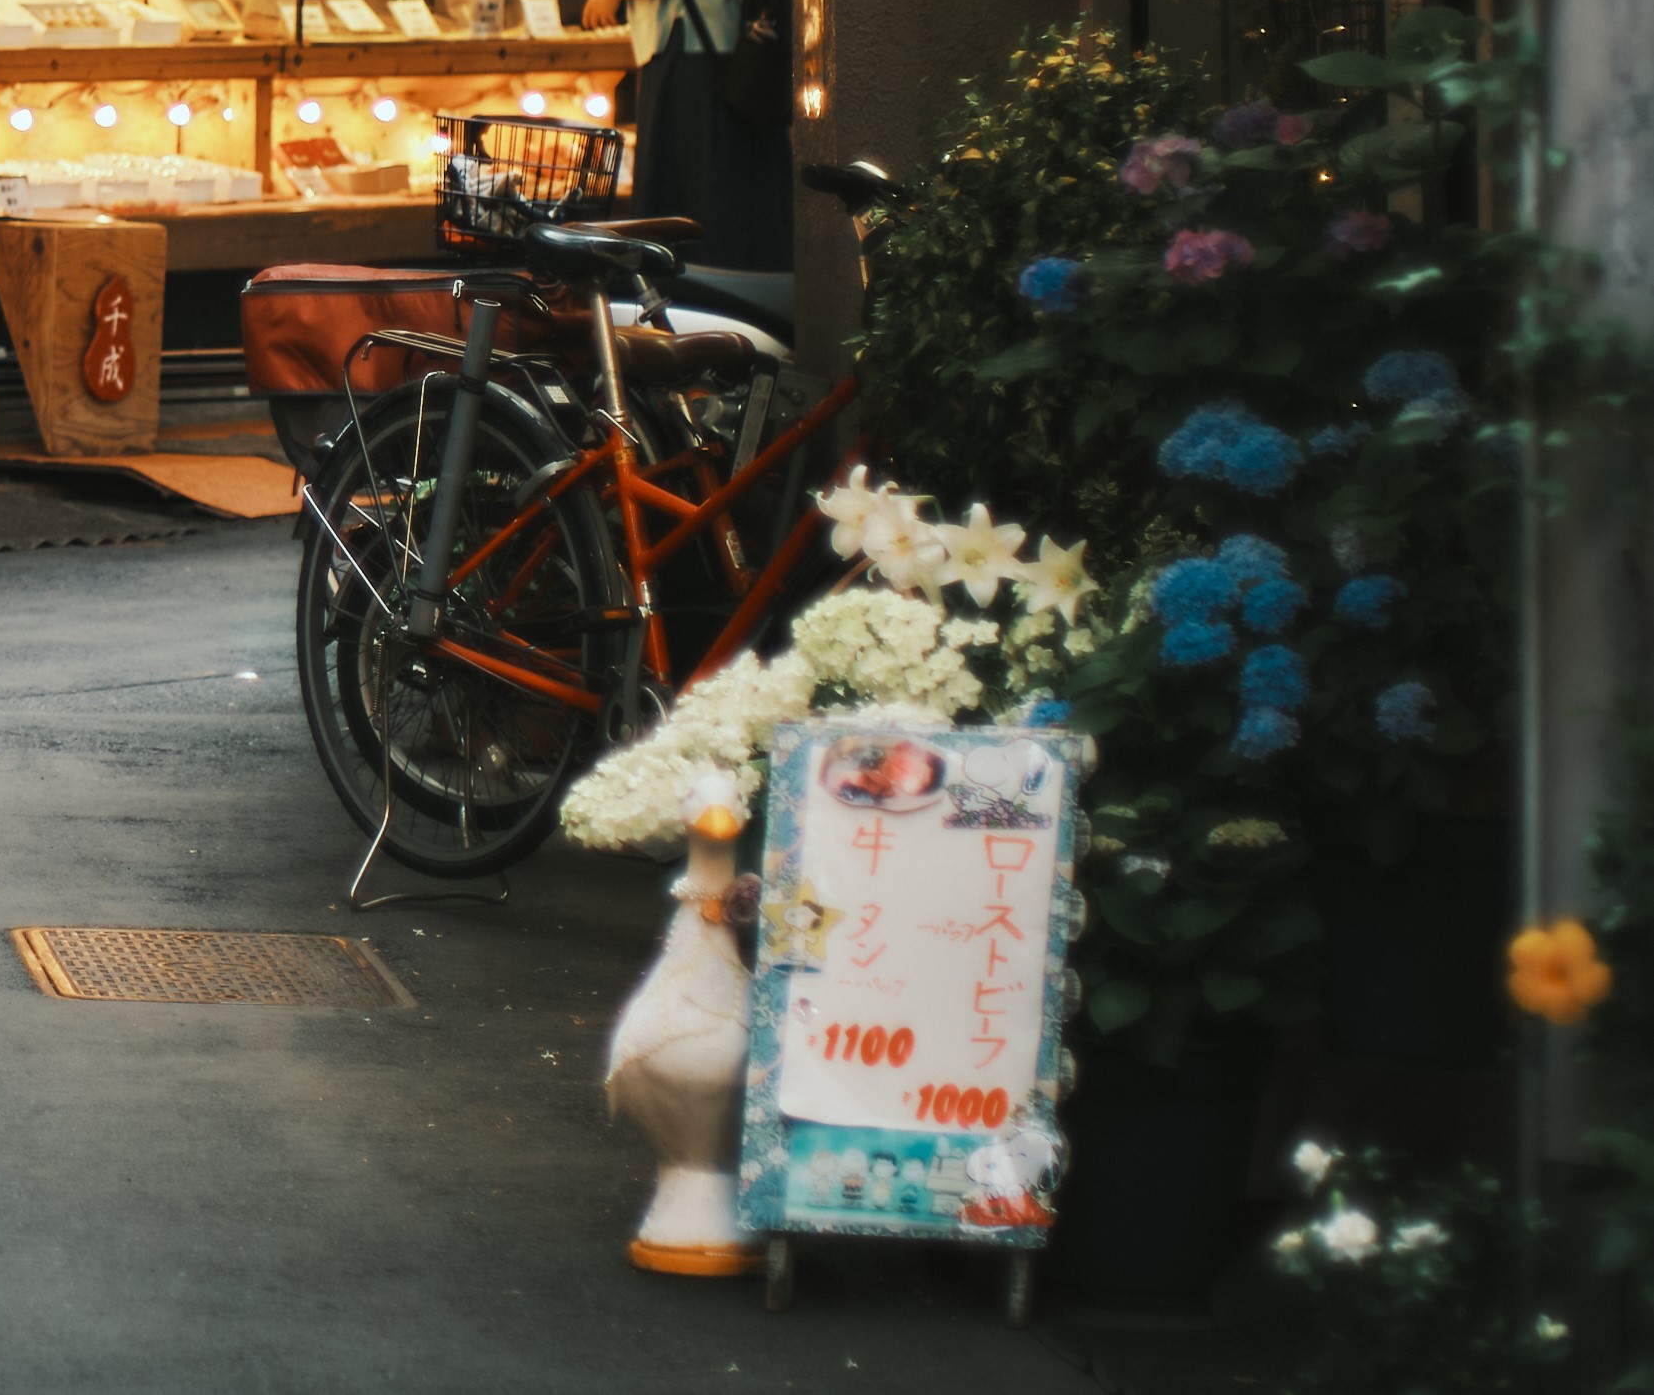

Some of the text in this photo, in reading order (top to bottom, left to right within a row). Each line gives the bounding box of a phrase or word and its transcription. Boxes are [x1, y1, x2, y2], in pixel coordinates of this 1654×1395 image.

[102, 294, 129, 391] 千成
[971, 834, 1036, 1070] ローストビーフ
